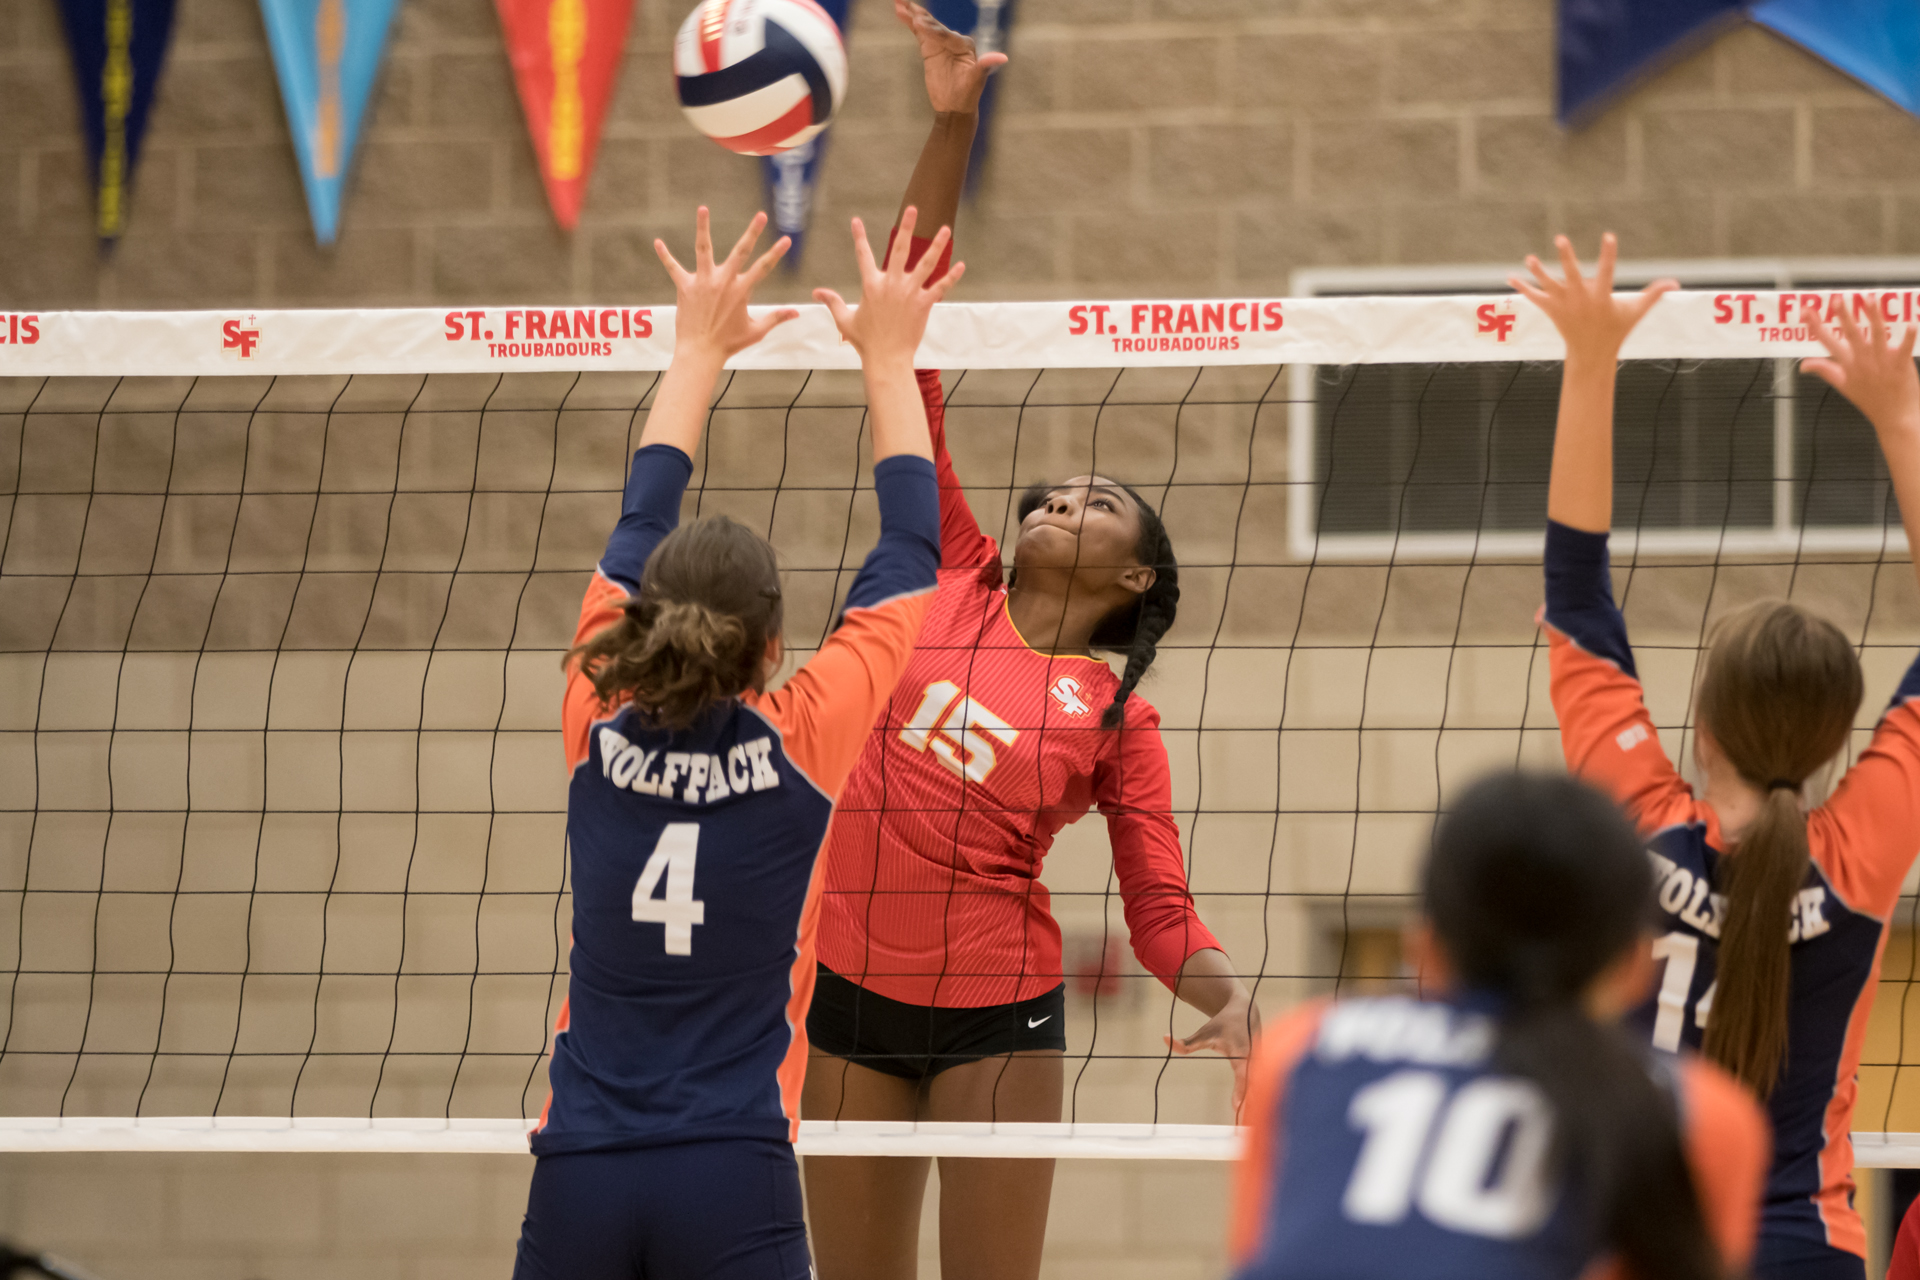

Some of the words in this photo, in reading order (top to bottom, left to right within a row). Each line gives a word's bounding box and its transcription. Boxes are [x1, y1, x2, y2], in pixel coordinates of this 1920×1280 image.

[445, 311, 494, 341] ST.
[505, 309, 653, 340] FRANCIS
[1068, 305, 1118, 335] ST.
[1131, 302, 1284, 334] FRANCIS
[1476, 303, 1516, 342] SF
[1714, 294, 1765, 324] ST.
[1779, 292, 1920, 324] FRANCI
[222, 318, 260, 358] SF
[488, 342, 612, 358] TROUBADOURS
[1111, 336, 1240, 352] TROUBADOURS
[1049, 676, 1092, 718] SF
[899, 679, 1020, 784] 15
[598, 727, 780, 804] WOLFPACK
[631, 822, 705, 957] 4
[1344, 1070, 1556, 1240] 10
